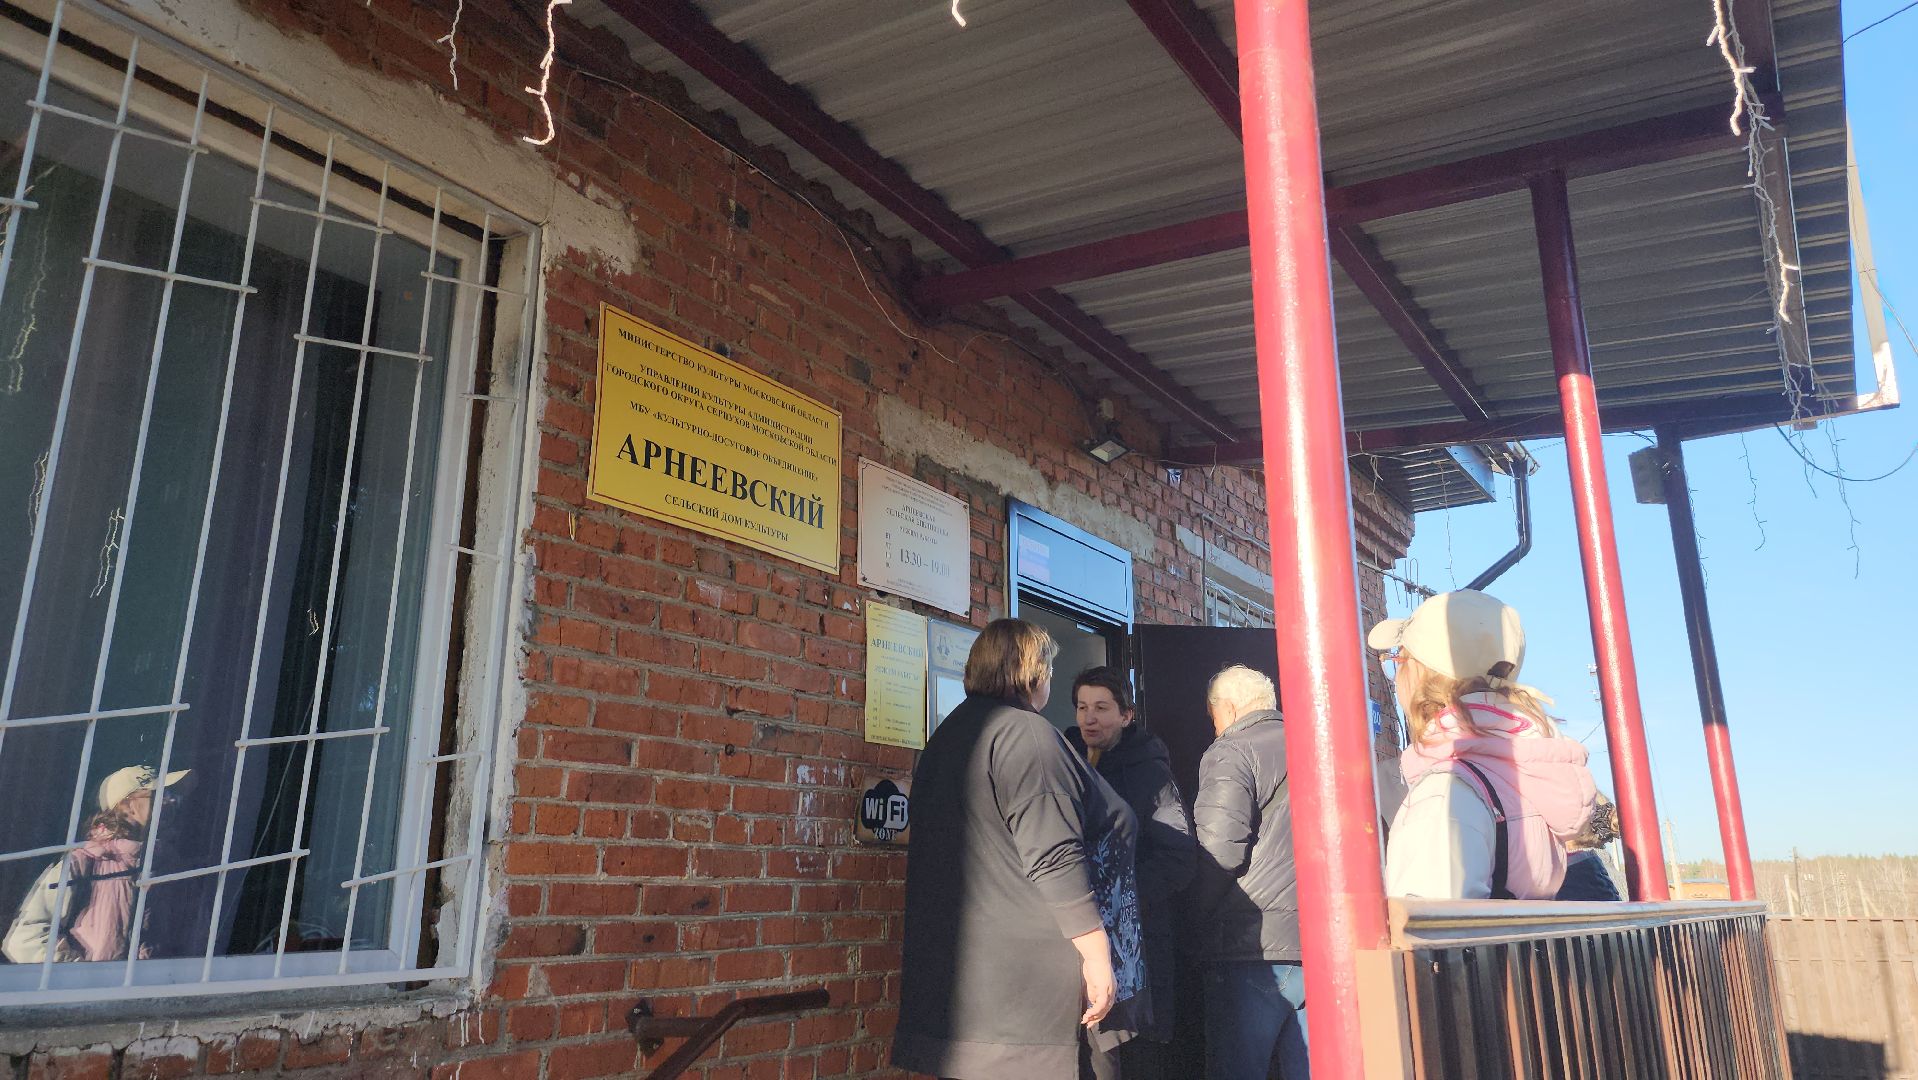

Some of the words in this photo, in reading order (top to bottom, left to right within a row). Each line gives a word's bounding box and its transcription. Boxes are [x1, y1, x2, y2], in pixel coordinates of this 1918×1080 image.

[618, 328, 695, 369] МИНИСТЕРСТВО
[697, 362, 741, 389] КУЛЬТУРЫ
[743, 385, 796, 413] МОСКОВСКОЙ
[797, 407, 829, 429] ОБЛАСТИ
[640, 363, 700, 396] УПРАВЛЕНИЯ
[702, 390, 746, 415] КУЛЬТУРЫ
[748, 410, 813, 445] АДМИНИСТРАЦИИ
[606, 362, 669, 396] ГОРОДСКОГО
[671, 390, 704, 411] ОКРУГА
[707, 405, 750, 429] СЕРПУХОВ
[752, 424, 804, 452] МОСКОВСКОЙ
[805, 447, 837, 467] ОБЛАСТИ
[630, 400, 651, 415] МБУ
[653, 411, 761, 458] «КУЛЬТУРНО-ДОСУГОВОЕ
[616, 433, 825, 530] АРНЕЕВСКИЙ
[664, 493, 720, 518] СЕЛЬСКИЙ
[721, 511, 742, 527] ДОМ
[744, 518, 789, 542] КУЛЬТУРЫ
[900, 548, 922, 568] 13.30
[870, 637, 924, 658] АРНЕЕВСКИЙ
